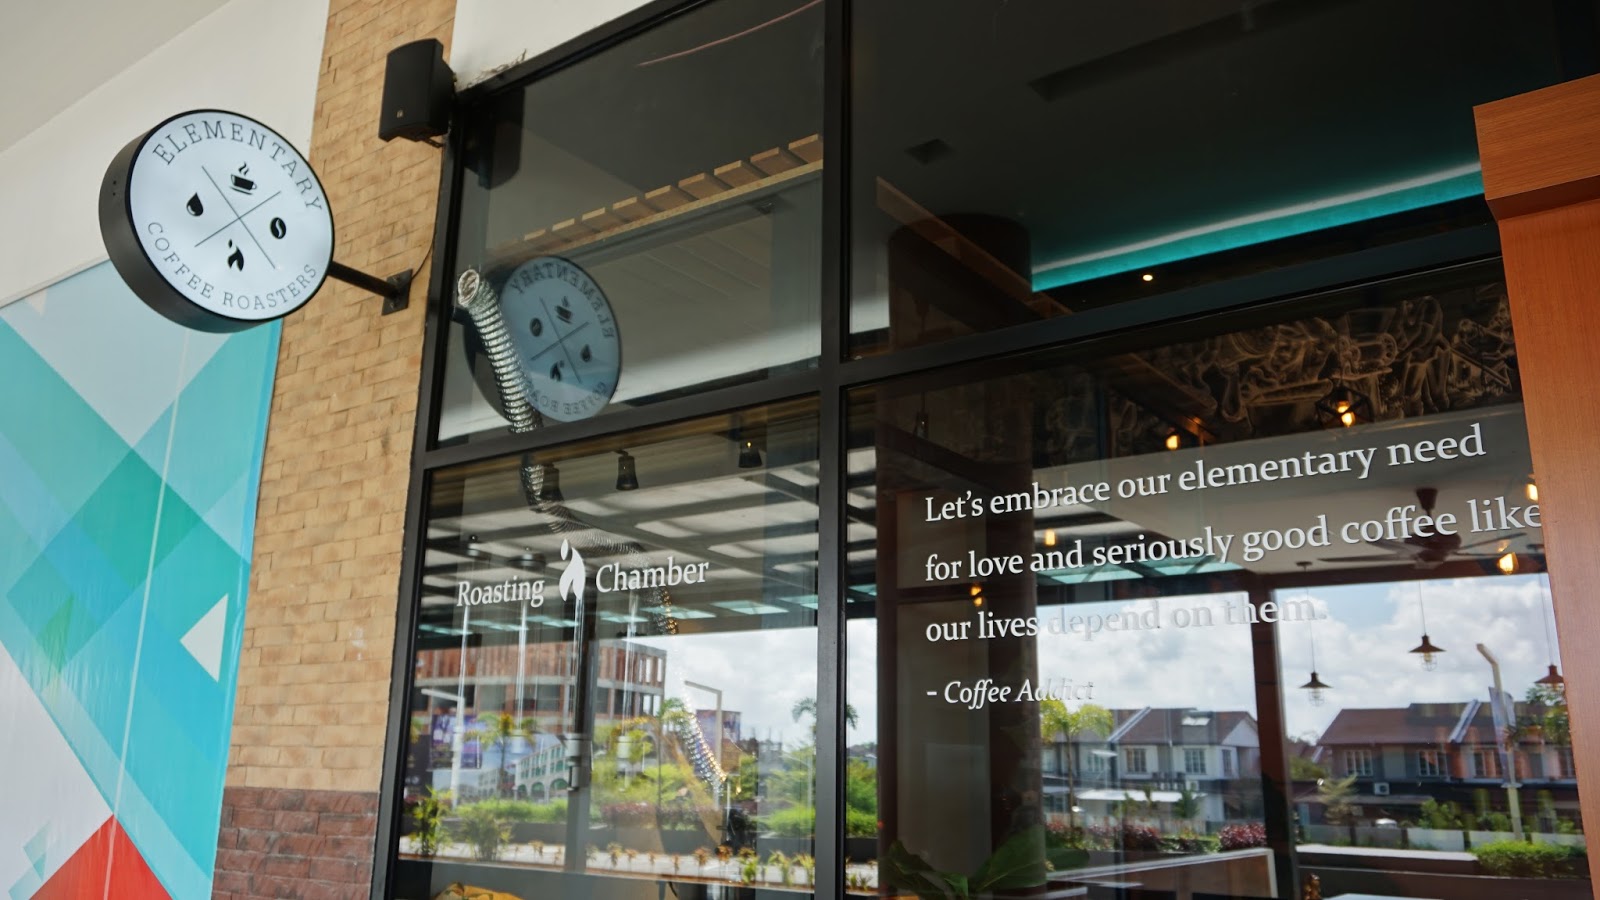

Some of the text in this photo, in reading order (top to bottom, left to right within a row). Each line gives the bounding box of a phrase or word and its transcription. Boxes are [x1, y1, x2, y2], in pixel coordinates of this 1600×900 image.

[153, 120, 322, 211] ELEMENTARY
[148, 222, 316, 310] COFFEE ROASTERS
[990, 482, 1110, 514] embrace
[1118, 473, 1171, 499] our
[1178, 447, 1377, 491] elementary
[1386, 423, 1486, 466] need
[925, 496, 1542, 581] for love and seriously good coffee like
[457, 556, 709, 607] Roasting Chamber
[926, 599, 1327, 641] our lives depend on them.
[944, 679, 1011, 710] Coffee
[1015, 678, 1094, 702] Addict
